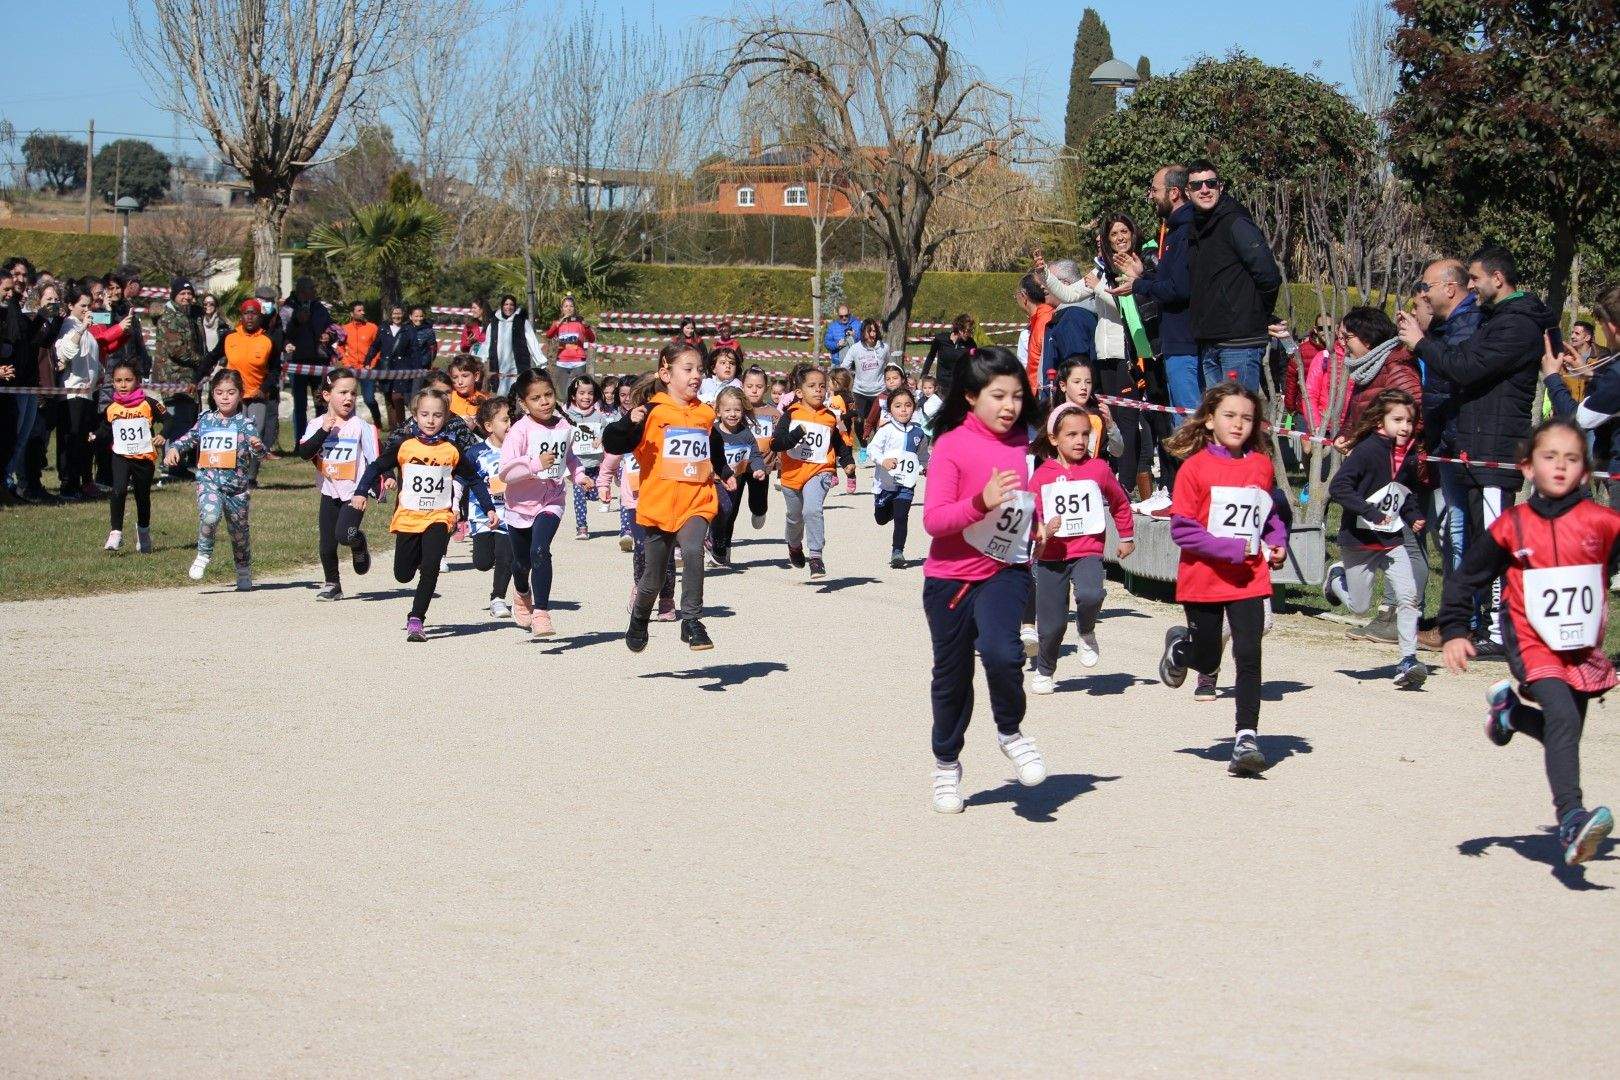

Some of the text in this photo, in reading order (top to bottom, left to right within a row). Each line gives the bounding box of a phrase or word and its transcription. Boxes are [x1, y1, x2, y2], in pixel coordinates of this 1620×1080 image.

[120, 427, 143, 441] 831
[202, 437, 233, 449] 2775
[319, 447, 353, 460] 777
[540, 441, 566, 459] 849
[669, 439, 707, 458] 2764
[412, 476, 444, 493] 834
[1055, 493, 1090, 514] 851
[996, 507, 1023, 534] 52
[1223, 504, 1260, 528] 276
[1543, 586, 1593, 617] 270
